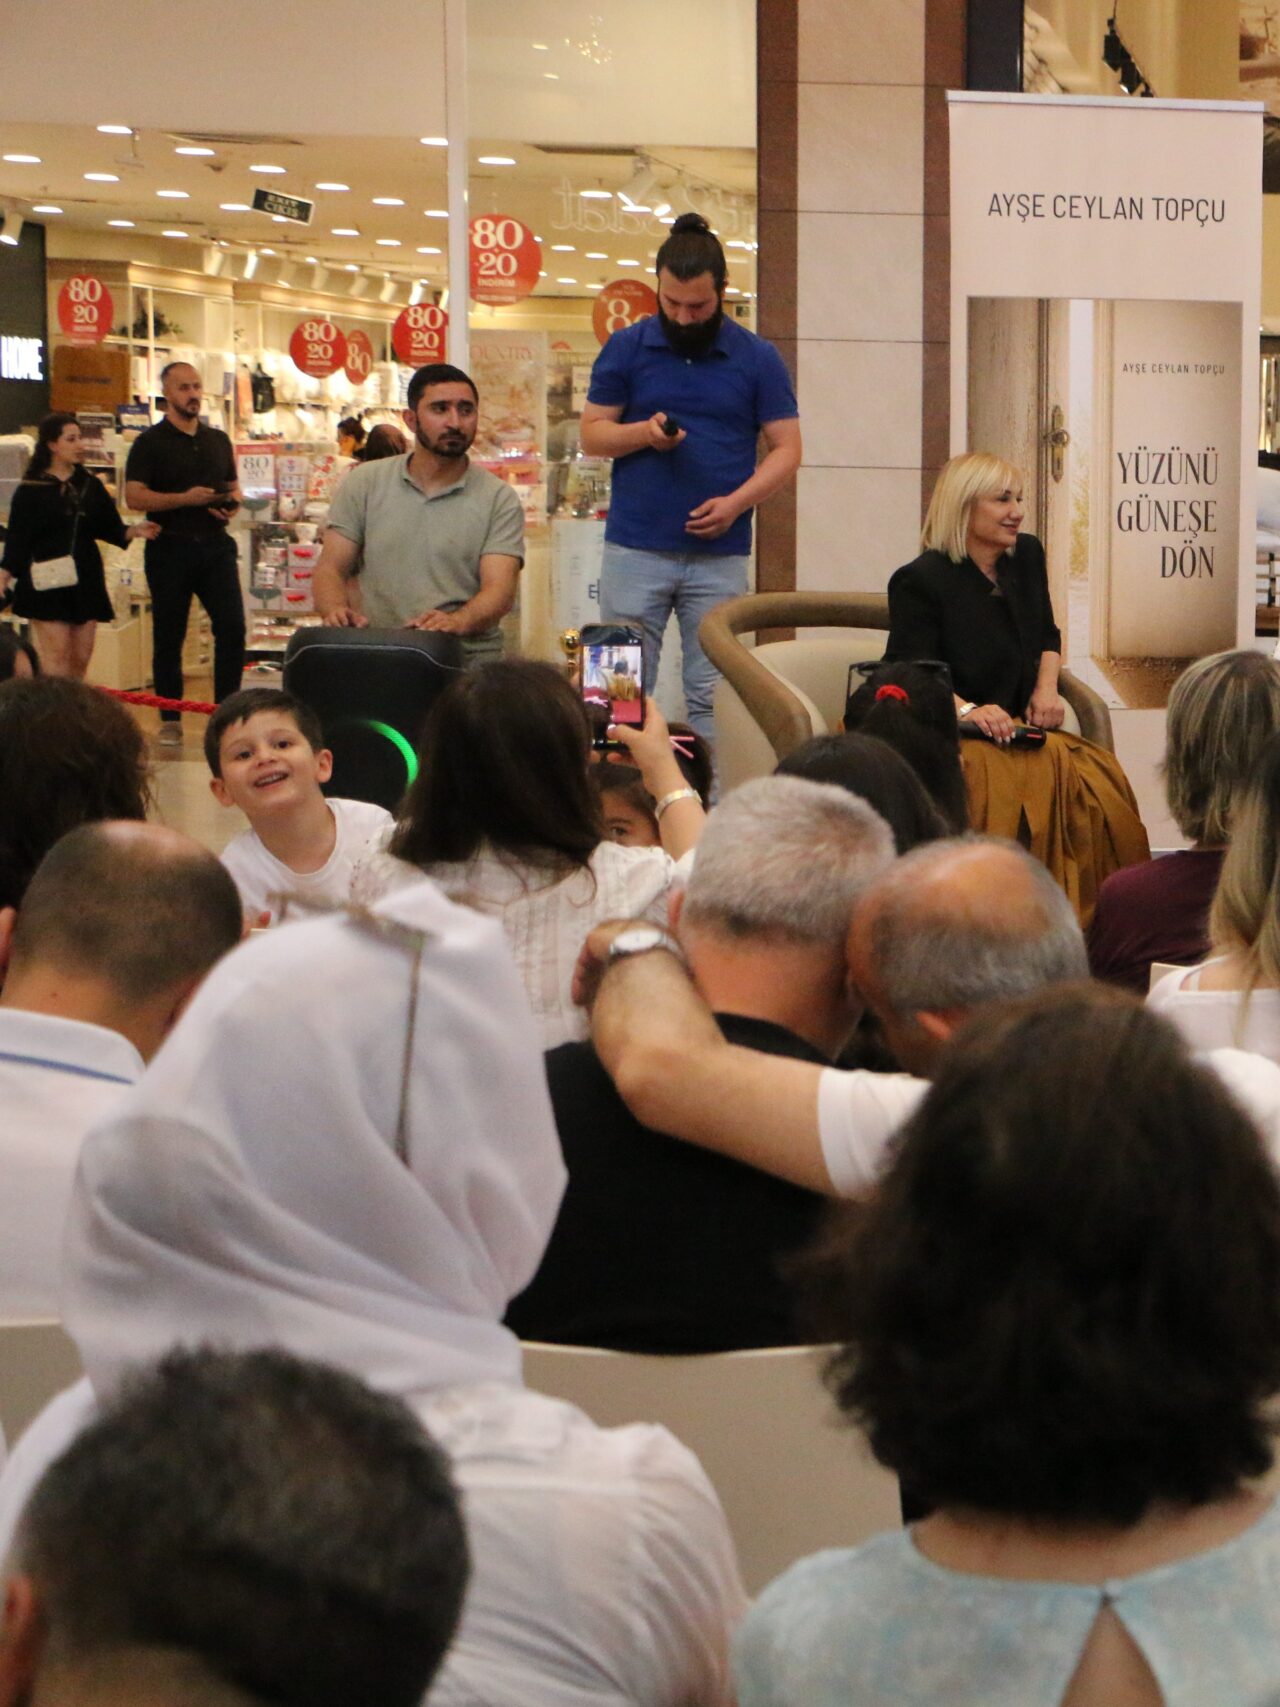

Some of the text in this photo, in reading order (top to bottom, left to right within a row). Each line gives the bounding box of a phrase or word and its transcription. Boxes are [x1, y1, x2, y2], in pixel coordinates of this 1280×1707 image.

[988, 192, 1226, 227] AYŞE CEYLAN TOPÇU
[472, 219, 524, 250] 80
[479, 252, 518, 276] 20
[69, 278, 102, 302] 80
[73, 304, 99, 323] 20
[407, 306, 443, 329] 80
[303, 322, 337, 342] 80
[411, 331, 440, 349] 20
[306, 343, 333, 359] 20
[347, 343, 371, 375] 80
[1122, 363, 1225, 376] AYŞE CEYLAN TOPÇU
[1117, 446, 1218, 485] YÜZÜNÜ
[1117, 494, 1217, 538] GÜNEŞE
[1160, 540, 1214, 579] DÖN
